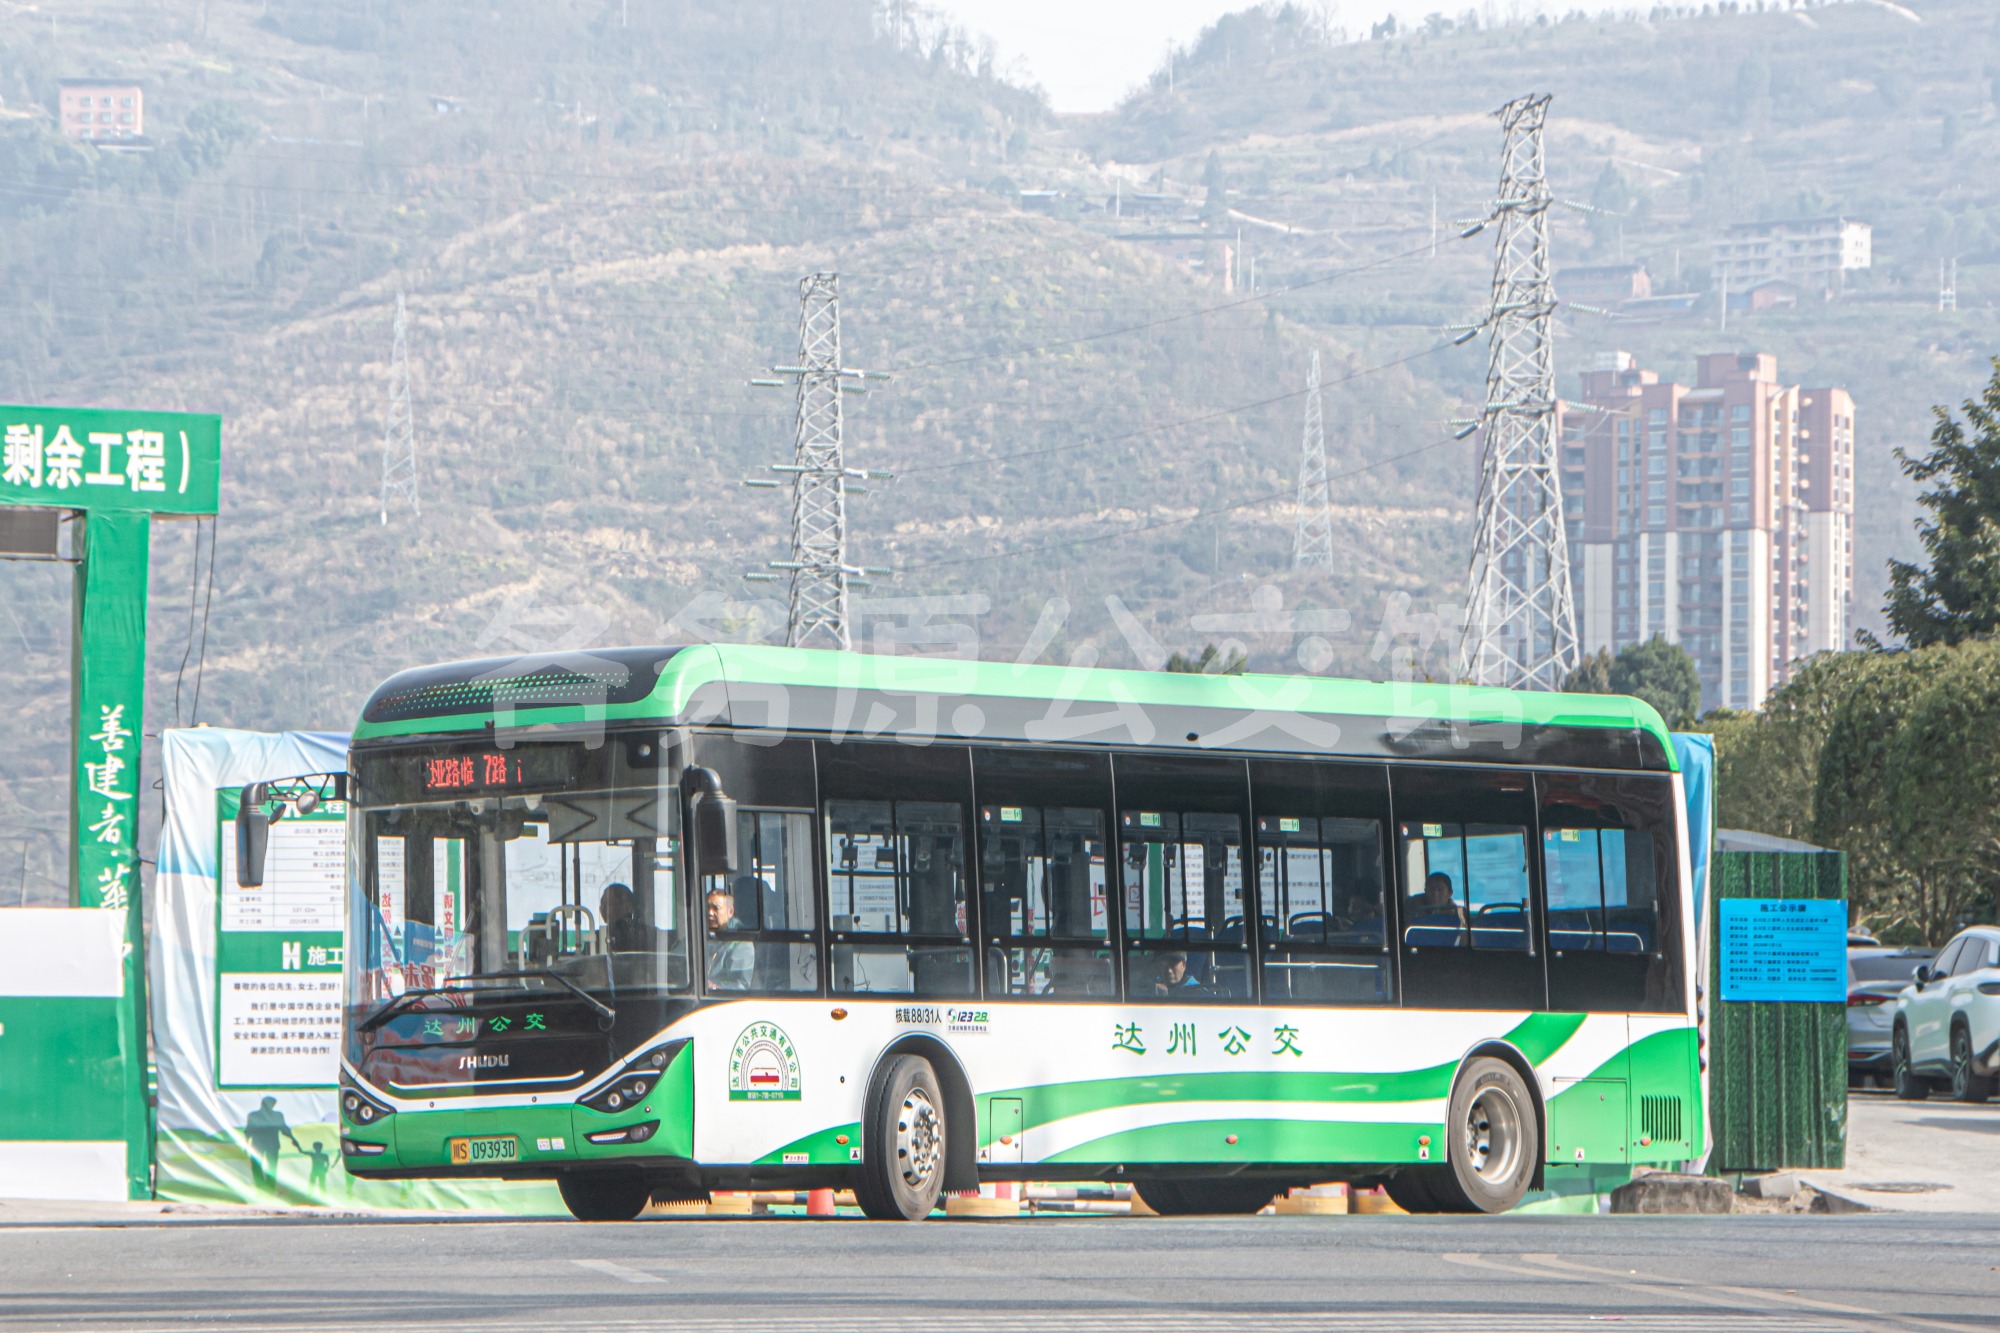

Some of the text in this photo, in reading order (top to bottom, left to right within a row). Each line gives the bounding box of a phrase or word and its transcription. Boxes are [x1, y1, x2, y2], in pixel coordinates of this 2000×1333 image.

[422, 1012, 546, 1036] 达州公交
[1112, 1021, 1304, 1057] 达州公交
[458, 1054, 509, 1070] SHUDU
